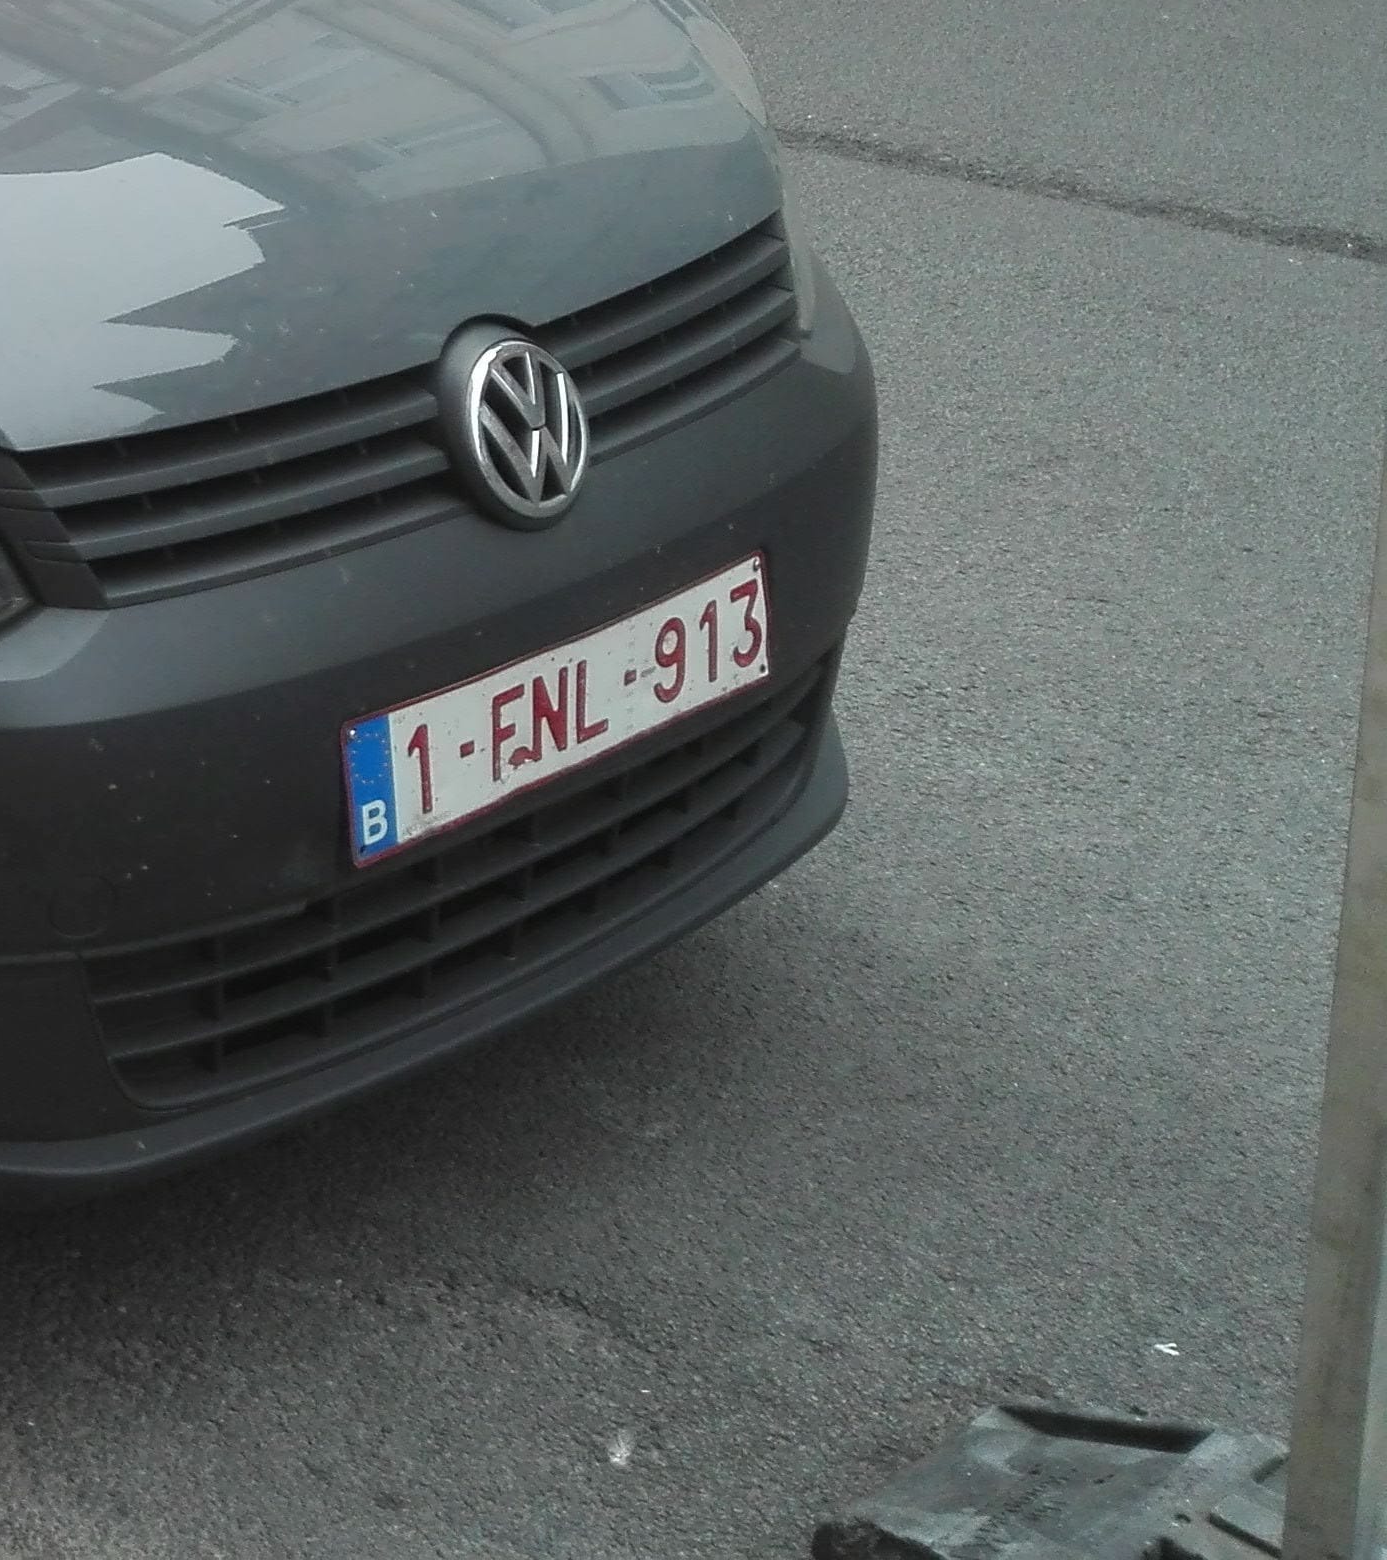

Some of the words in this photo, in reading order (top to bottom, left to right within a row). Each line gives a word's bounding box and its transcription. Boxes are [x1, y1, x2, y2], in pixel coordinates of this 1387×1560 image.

[467, 340, 588, 517] VW
[407, 578, 763, 814] 1-FNL-913
[361, 798, 388, 846] B
